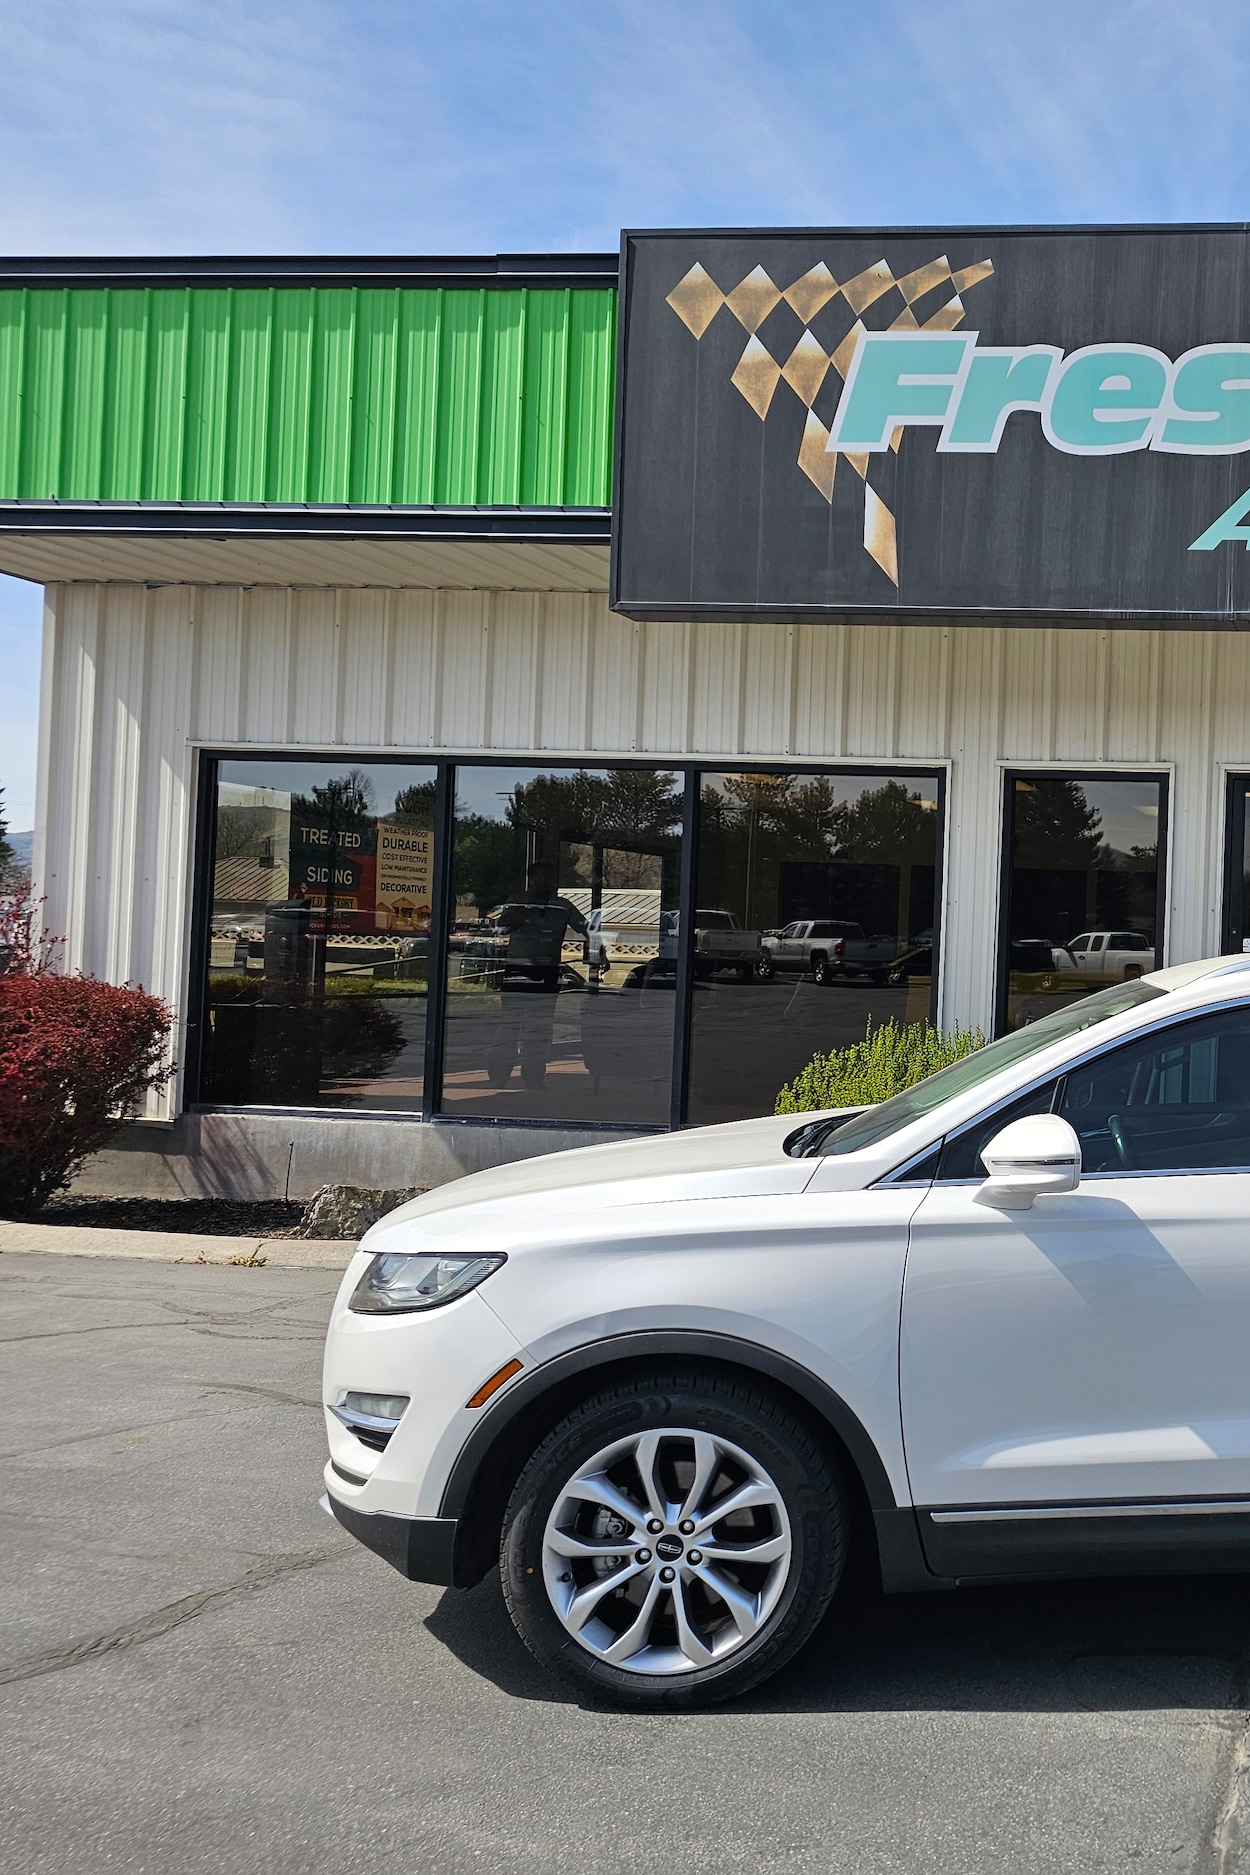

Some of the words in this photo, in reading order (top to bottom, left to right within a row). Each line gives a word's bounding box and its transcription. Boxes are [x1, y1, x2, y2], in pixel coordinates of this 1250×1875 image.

[300, 827, 361, 848] TREATED
[383, 826, 410, 836] WEATHER
[411, 830, 429, 838] PROOF
[382, 837, 428, 853] DURABLE
[381, 852, 398, 861] COST
[399, 854, 428, 864] EFFECTIVE
[394, 864, 428, 874] MAINTENANCE
[306, 866, 353, 885] SIDING
[380, 882, 428, 894] DECORATIVE
